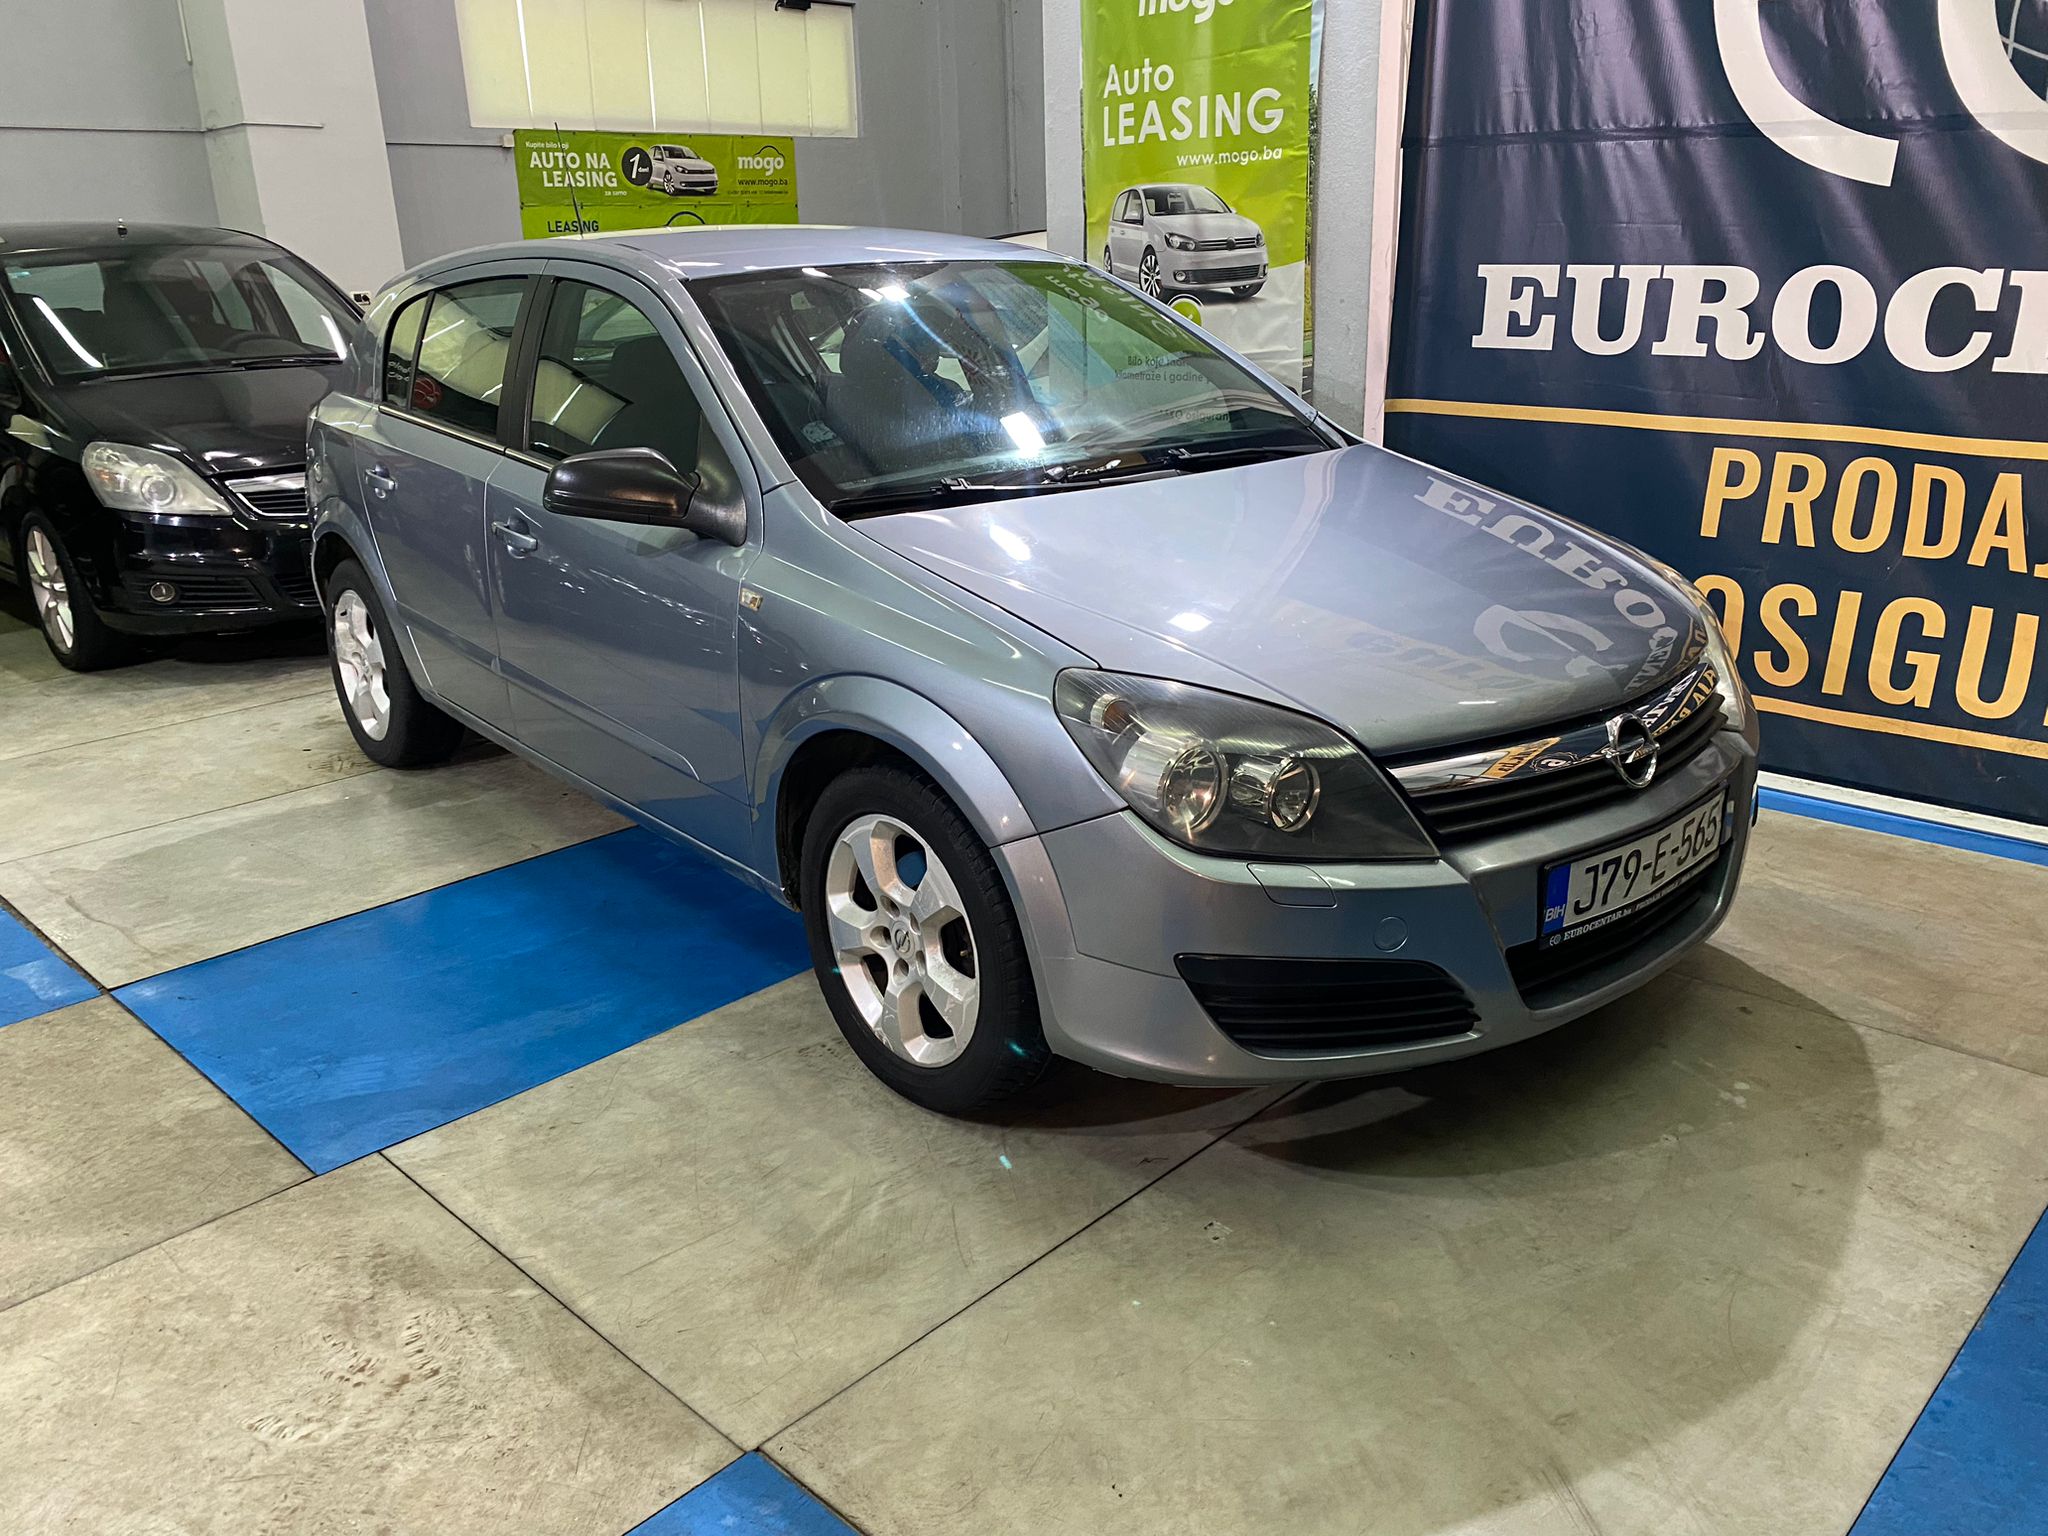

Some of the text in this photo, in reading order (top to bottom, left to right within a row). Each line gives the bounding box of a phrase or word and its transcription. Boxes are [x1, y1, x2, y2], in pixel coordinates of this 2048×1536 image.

[1138, 0, 1235, 24] mog
[1103, 58, 1175, 98] Auto
[1103, 87, 1284, 147] LEASING
[530, 151, 611, 169] AUTO NA
[629, 153, 640, 179] 1
[737, 156, 784, 176] mogo
[1176, 146, 1283, 166] www.mogo.ba
[543, 171, 618, 188] LEASING
[738, 179, 788, 187] www.mogo.ba
[1694, 574, 2048, 720] OSIGU
[1573, 800, 1720, 915] J79-E-565
[1545, 904, 1566, 923] BIH
